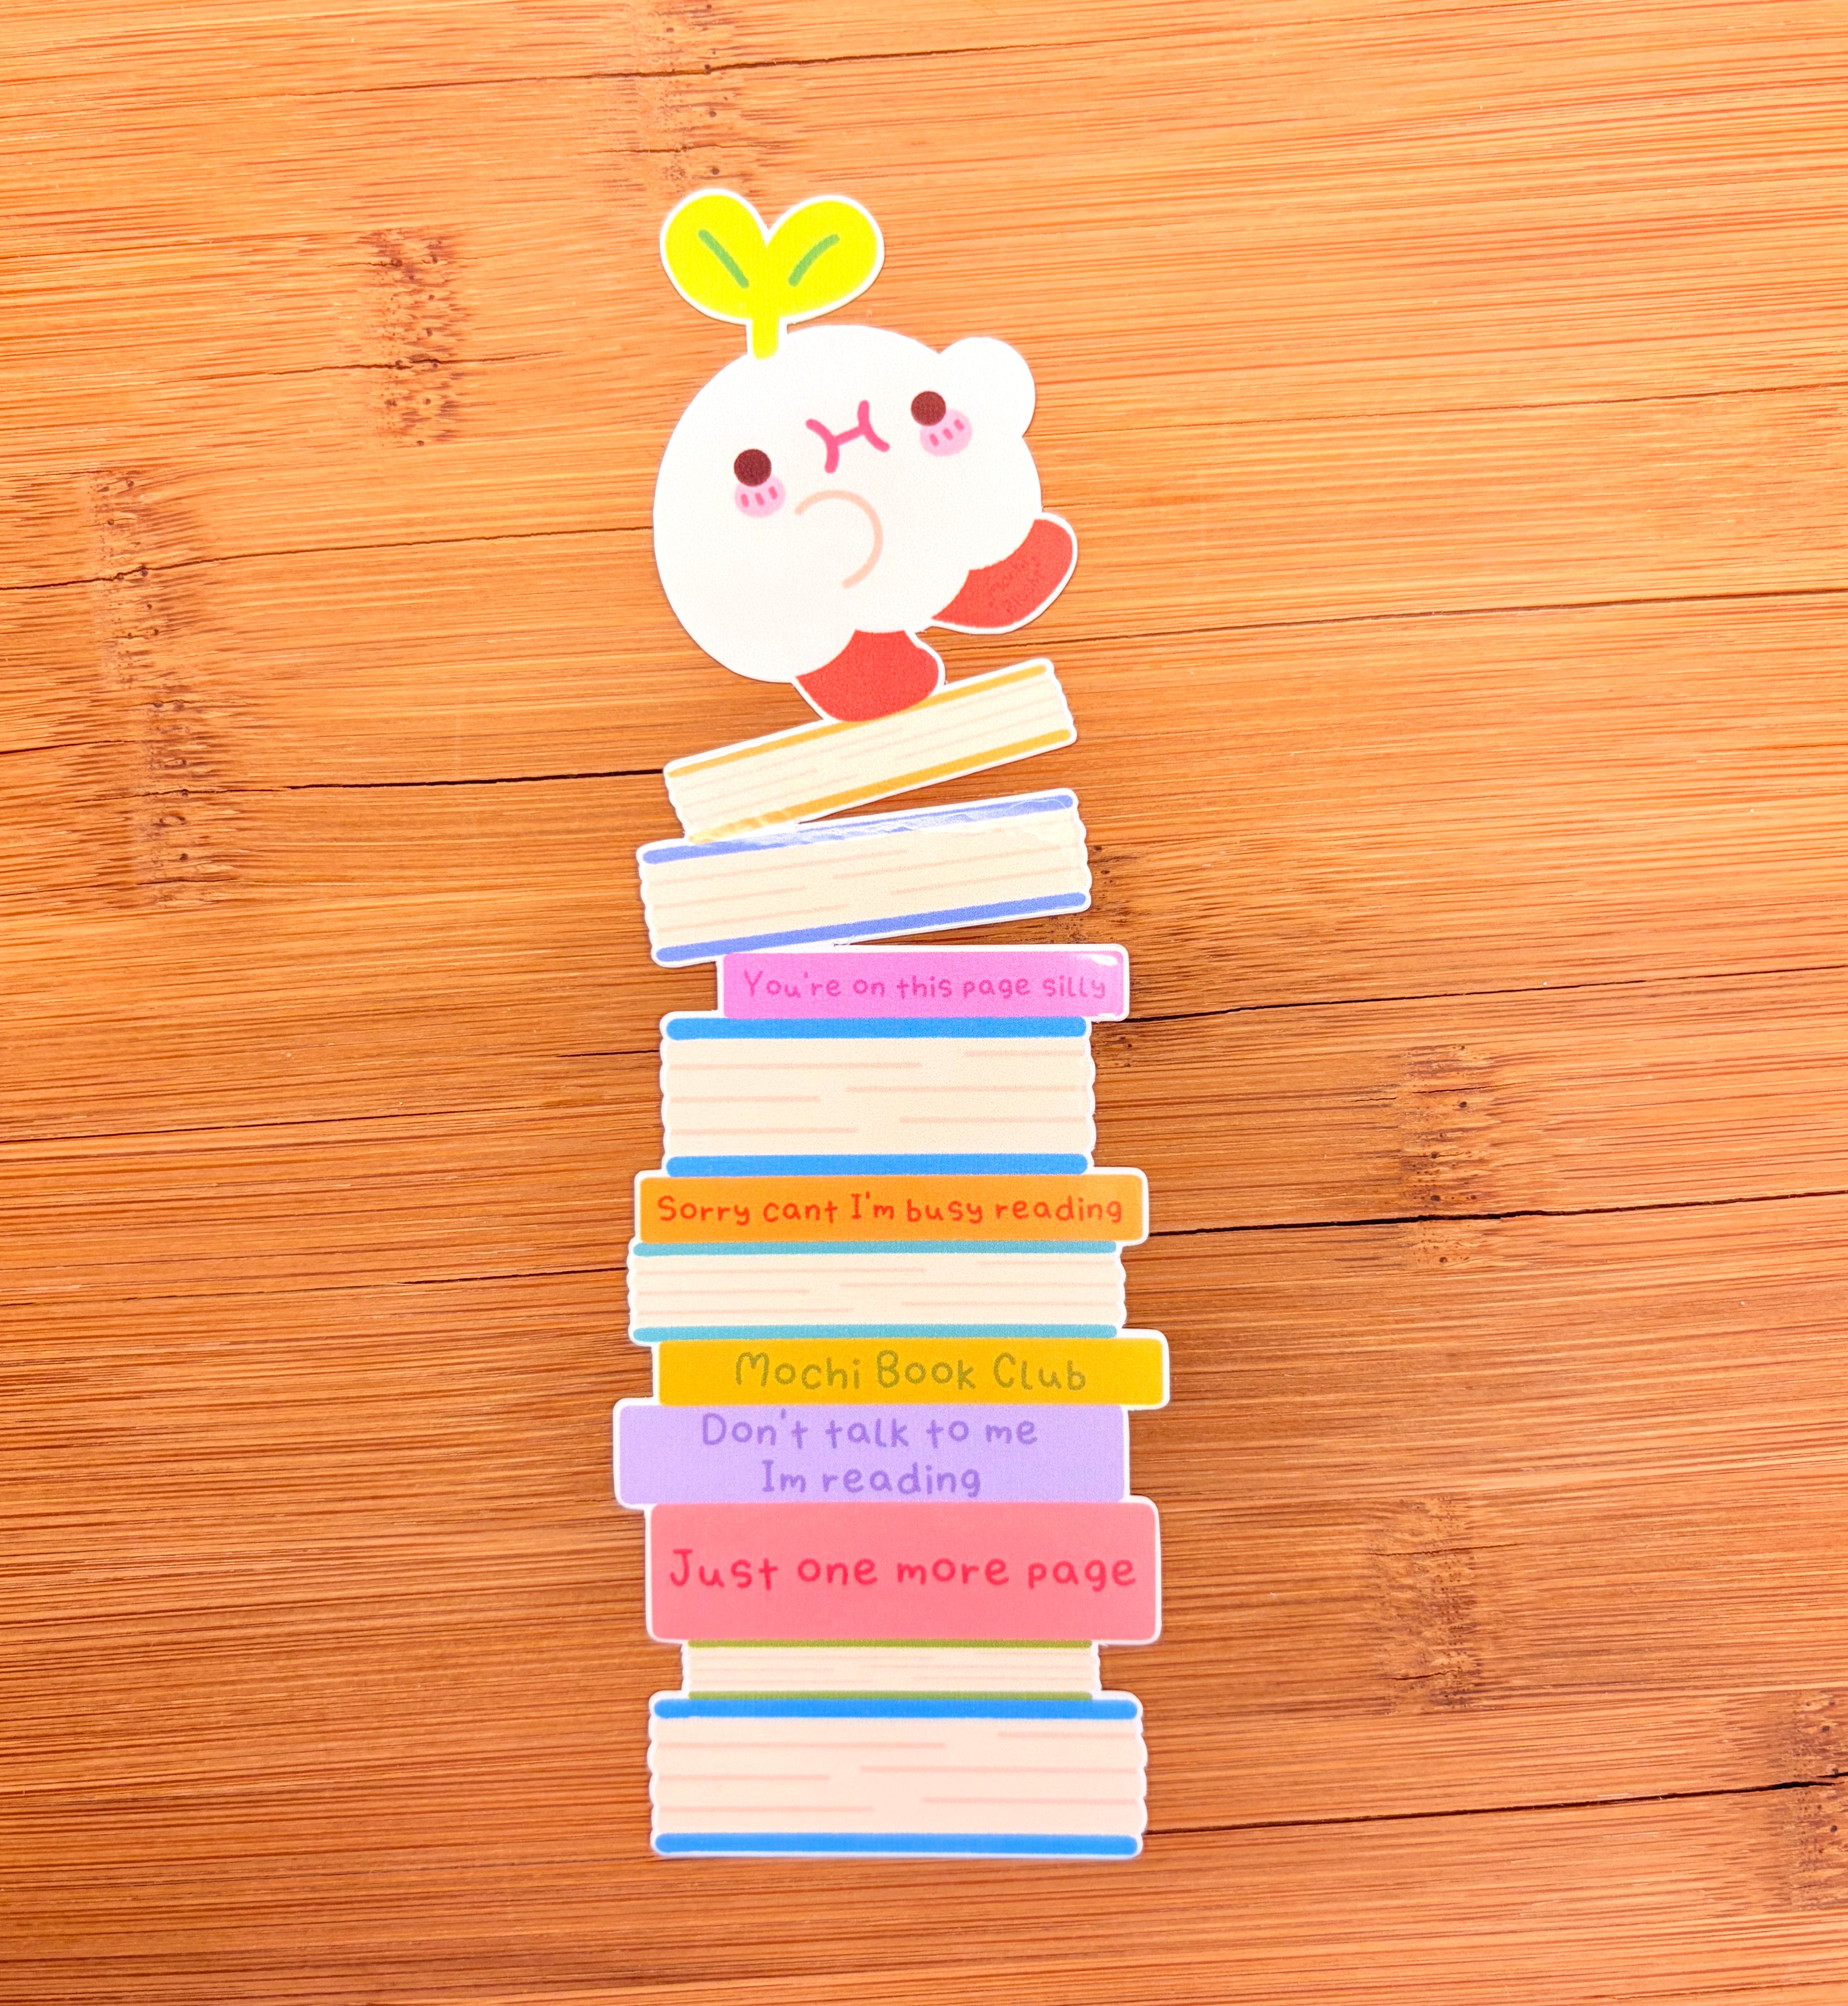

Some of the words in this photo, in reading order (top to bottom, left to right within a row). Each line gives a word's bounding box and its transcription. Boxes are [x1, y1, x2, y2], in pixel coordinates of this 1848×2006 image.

[744, 970, 841, 998] You're
[852, 979, 886, 997] on
[896, 975, 952, 999] this
[962, 978, 1030, 999] page
[1042, 975, 1106, 998] silly
[657, 1195, 750, 1226] Sorry
[763, 1201, 838, 1224] cant
[851, 1191, 894, 1221] I'm
[907, 1199, 983, 1225] busy
[995, 1195, 1122, 1223] reading
[736, 1352, 860, 1390] Mochi
[876, 1350, 976, 1390] Book
[993, 1353, 1086, 1391] Club
[702, 1409, 808, 1449] Don't
[825, 1418, 909, 1449] talk
[926, 1419, 970, 1449] to
[986, 1419, 1038, 1445] me
[762, 1459, 807, 1493] Im
[822, 1462, 981, 1498] reading
[670, 1548, 778, 1591] Just
[797, 1558, 878, 1587] one
[897, 1558, 1010, 1586] more
[1028, 1559, 1136, 1592] page
